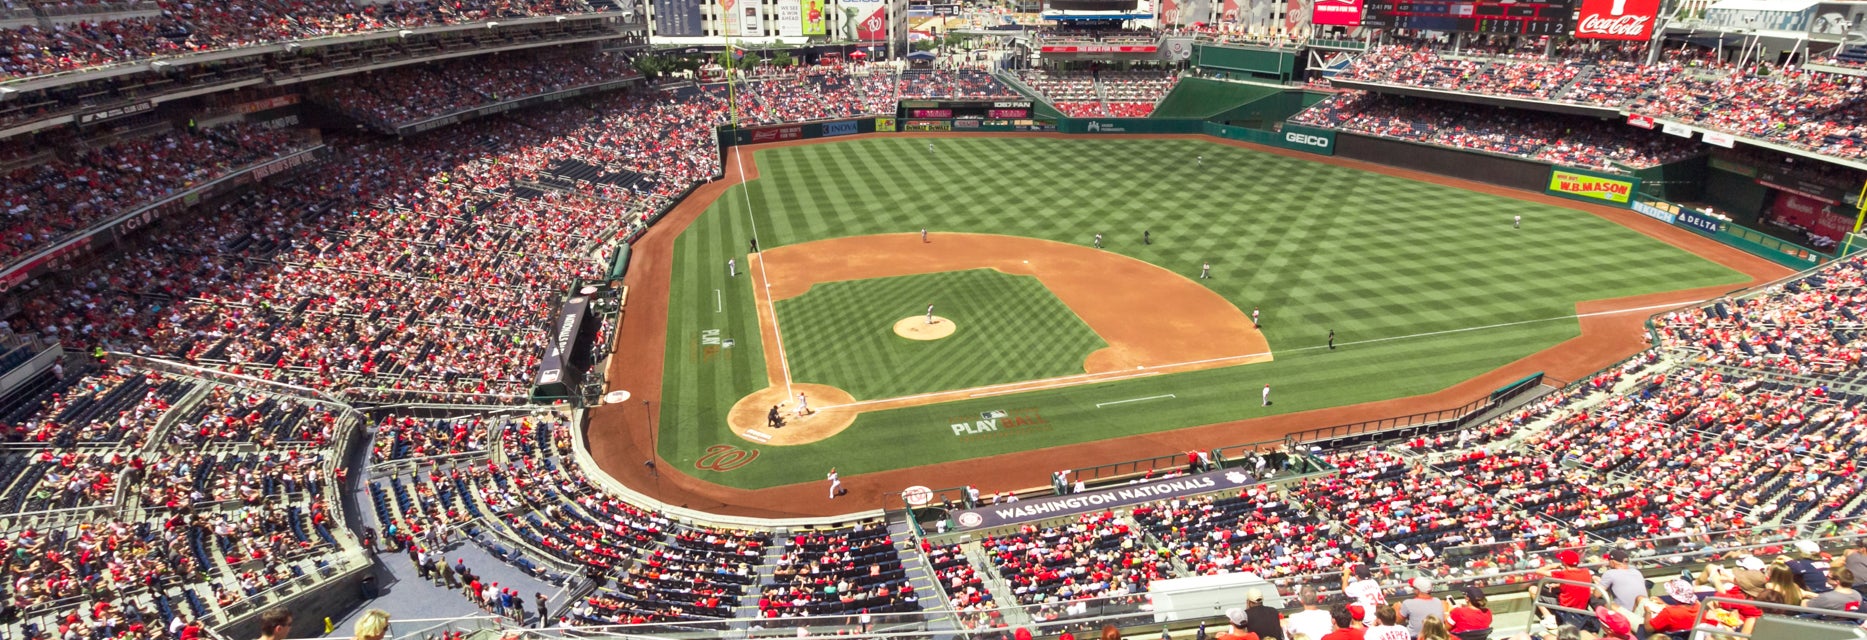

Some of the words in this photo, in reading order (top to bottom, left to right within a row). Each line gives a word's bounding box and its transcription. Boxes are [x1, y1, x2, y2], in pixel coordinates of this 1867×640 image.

[1531, 23, 1537, 31] 1
[1544, 23, 1549, 32] 1
[1555, 23, 1563, 33] 2
[831, 122, 857, 132] INOVA
[1286, 132, 1328, 147] GEICO
[1687, 215, 1716, 232] DELTA
[702, 329, 720, 345] PLAY
[951, 419, 998, 436] PLAY
[1001, 413, 1049, 428] BALL
[995, 489, 1119, 520] WASHINGTON
[1118, 476, 1216, 501] NATIONALS
